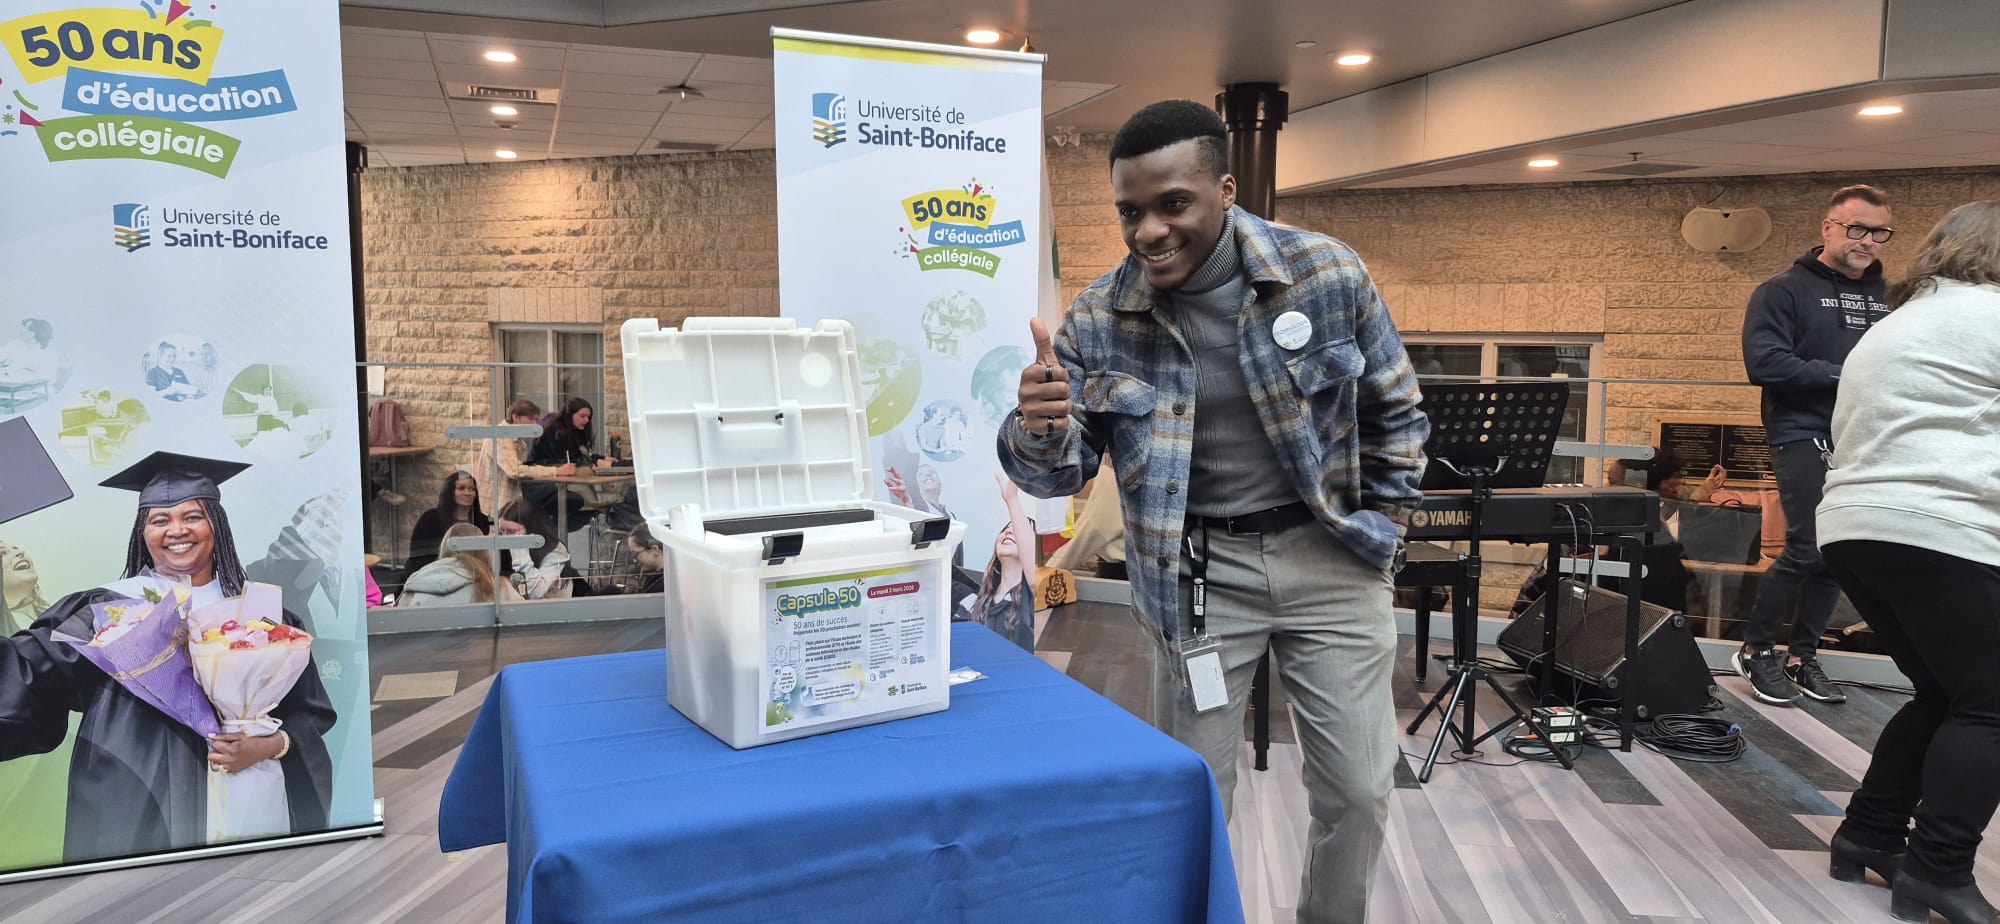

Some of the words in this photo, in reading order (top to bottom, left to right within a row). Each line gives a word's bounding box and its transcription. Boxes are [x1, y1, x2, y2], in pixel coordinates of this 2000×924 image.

[21, 21, 95, 68] 50
[102, 28, 203, 70] ans
[858, 99, 942, 124] Université
[946, 106, 965, 125] de
[54, 119, 225, 165] collégiale
[858, 122, 1006, 153] Saint-Boniface
[163, 207, 255, 227] Université
[259, 210, 281, 227] de
[912, 196, 943, 223] 50
[946, 199, 987, 222] ans
[163, 226, 329, 251] Saint-Boniface
[923, 248, 994, 271] collégiale
[1429, 510, 1482, 526] YAMAH
[776, 588, 837, 614] Capsule
[839, 586, 859, 605] 50
[793, 621, 802, 630] 50
[803, 620, 815, 629] ans
[826, 616, 848, 625] succès
